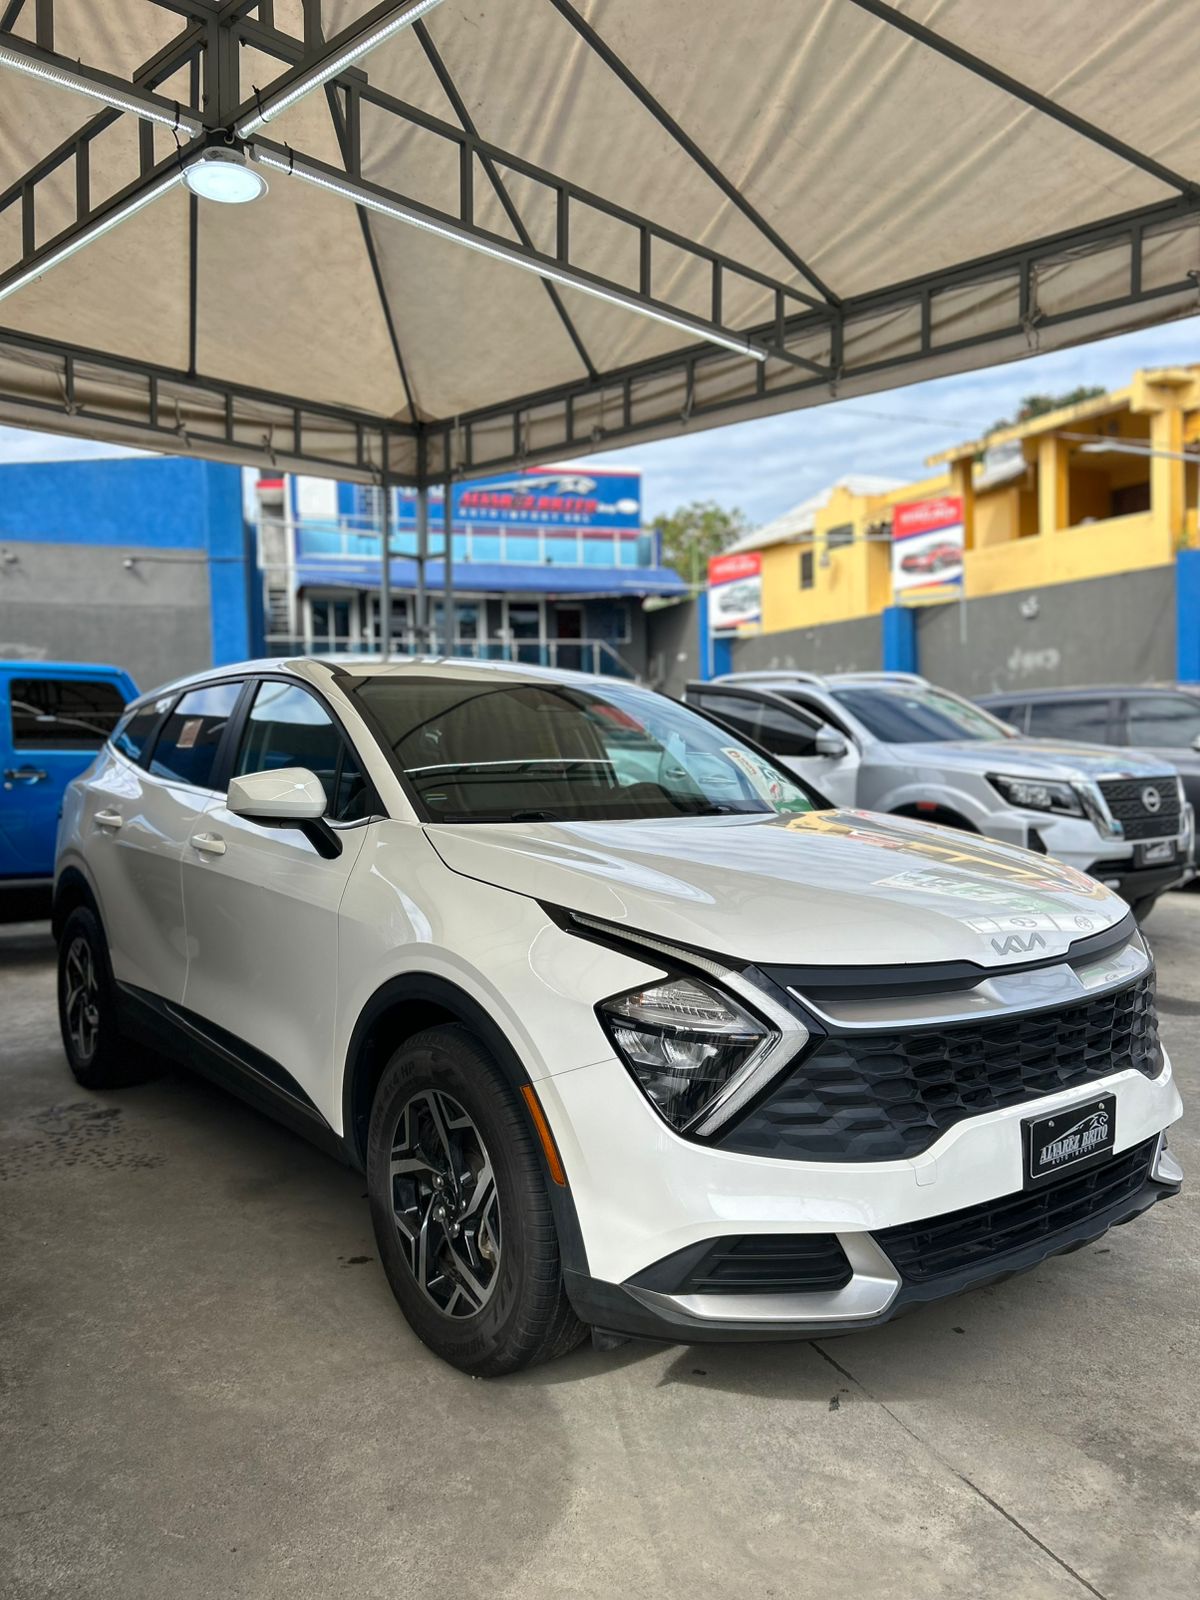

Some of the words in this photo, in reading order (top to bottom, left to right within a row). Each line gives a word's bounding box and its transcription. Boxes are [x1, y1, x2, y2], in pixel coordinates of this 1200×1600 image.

[1040, 1134, 1081, 1162] ALVAREZ
[1083, 1124, 1109, 1144] BRITO
[1051, 1153, 1069, 1165] AUTO
[1072, 1143, 1096, 1158] IMPORT
